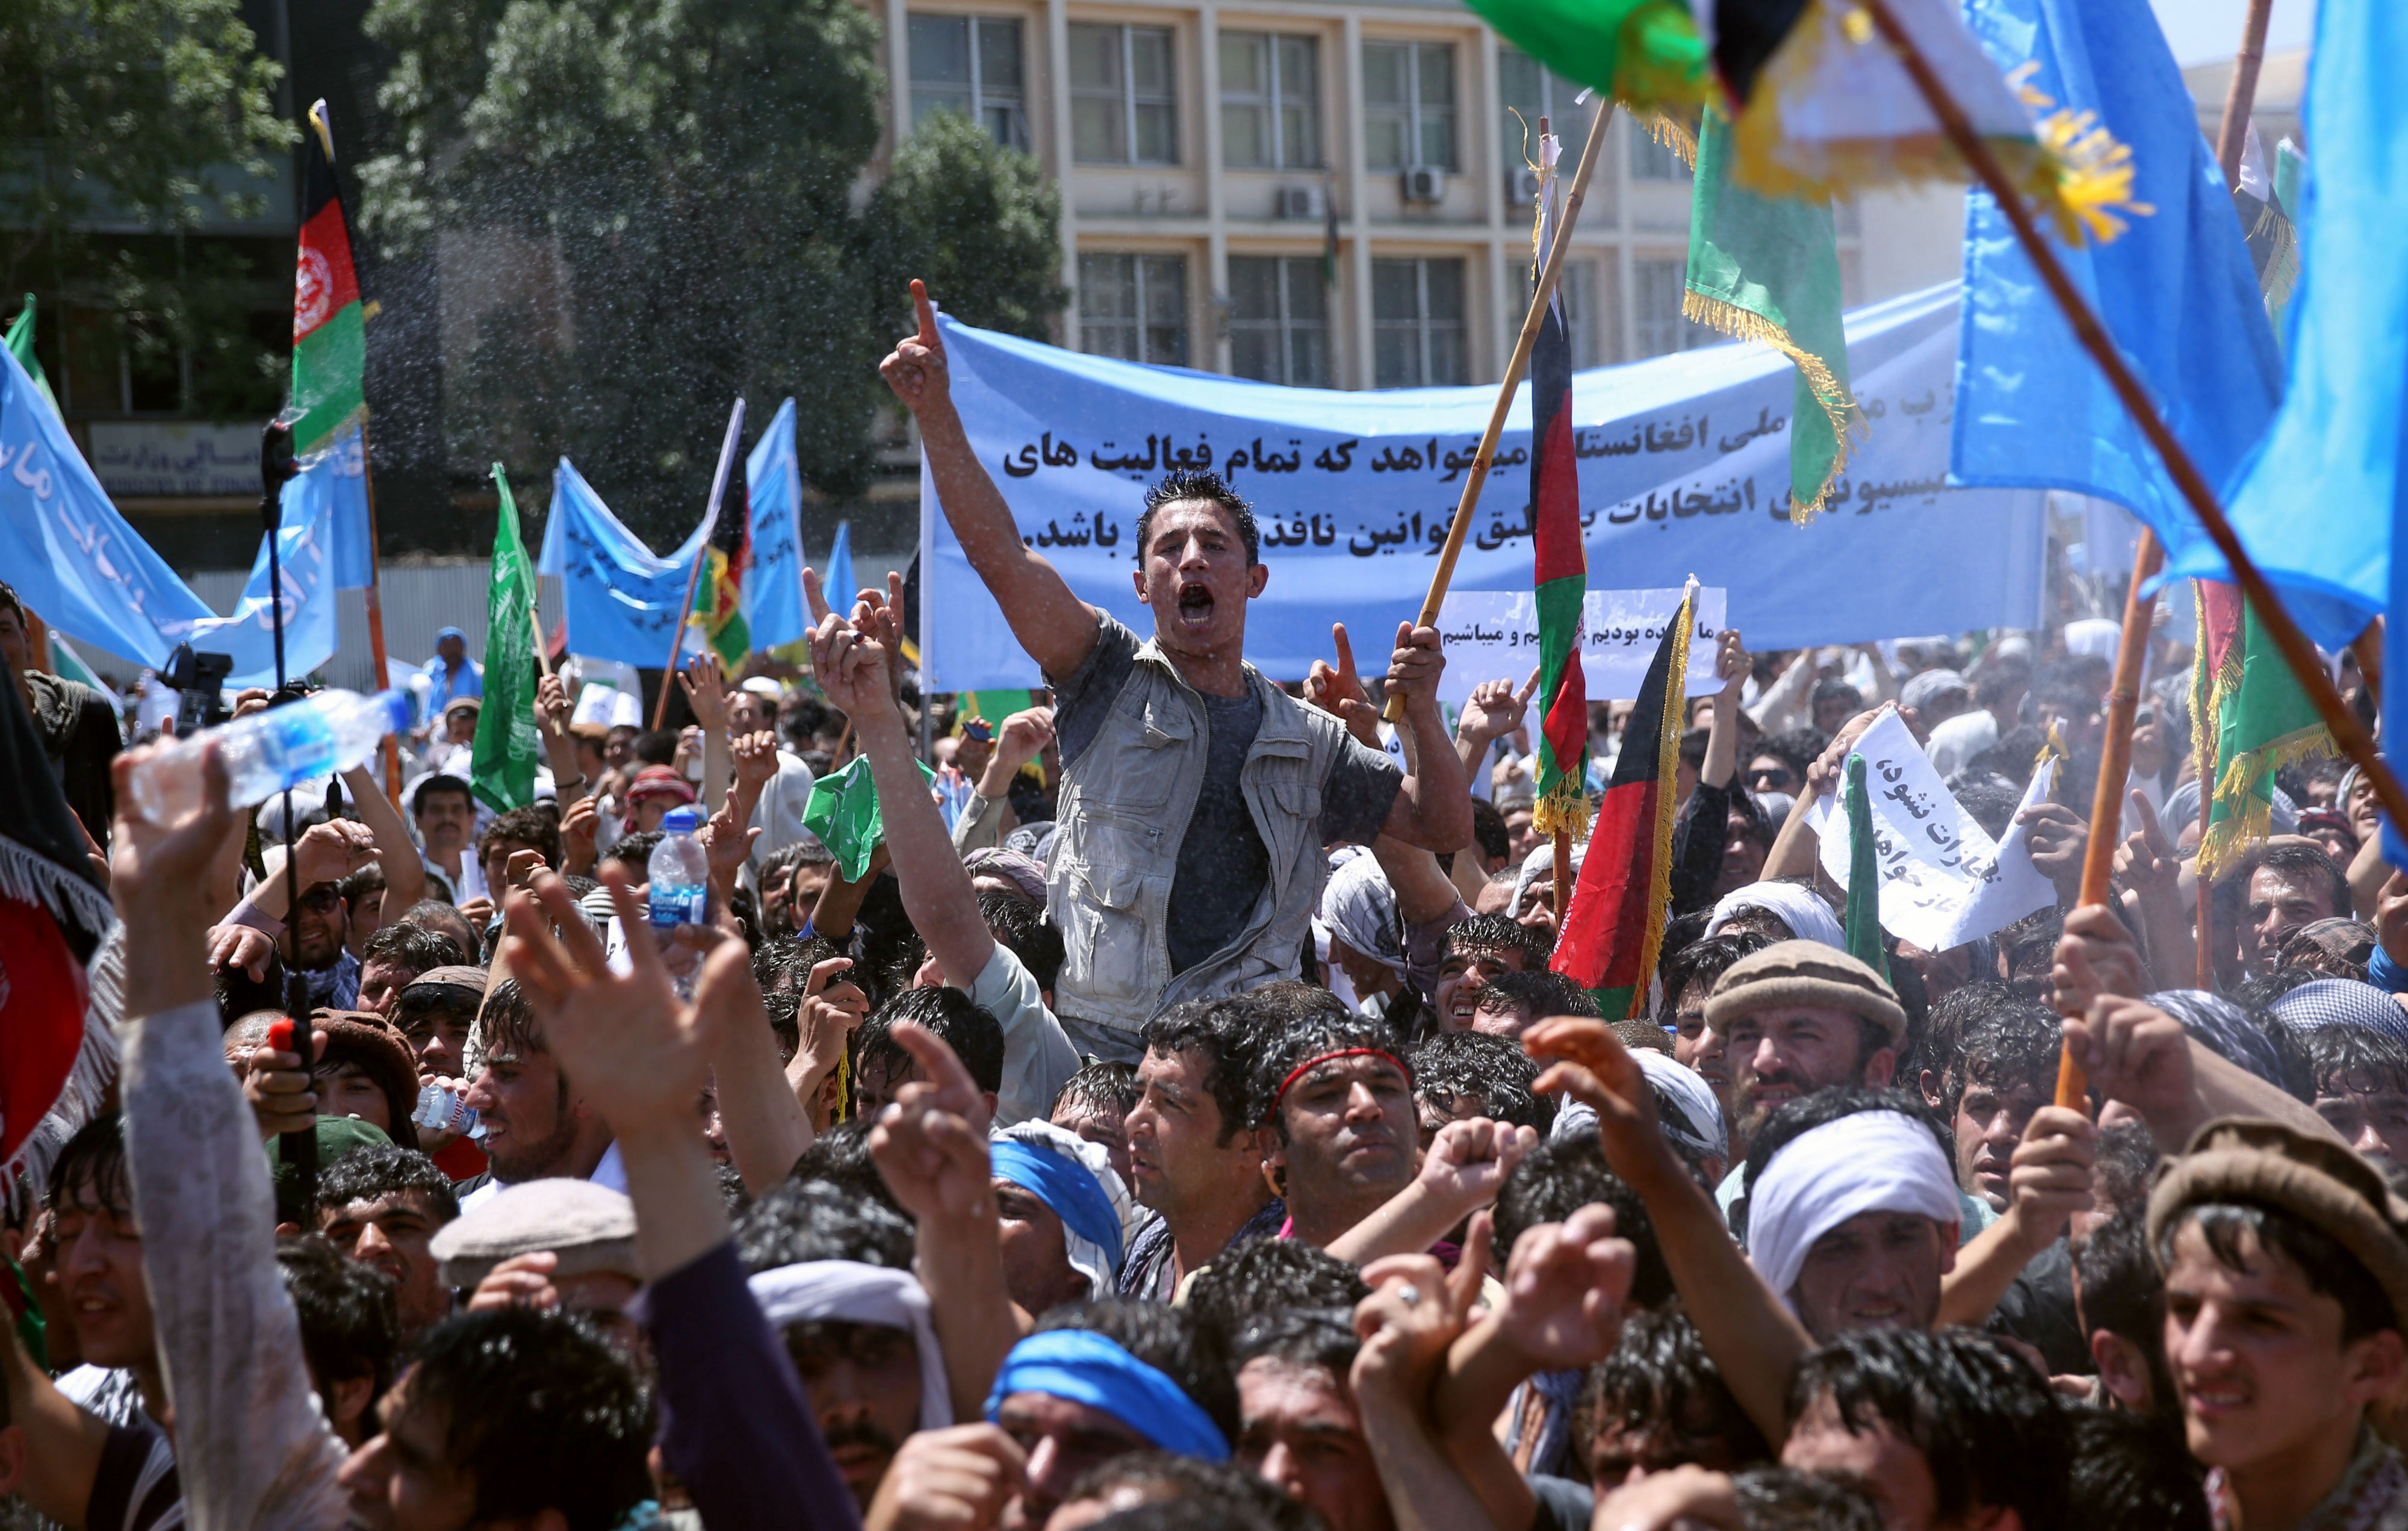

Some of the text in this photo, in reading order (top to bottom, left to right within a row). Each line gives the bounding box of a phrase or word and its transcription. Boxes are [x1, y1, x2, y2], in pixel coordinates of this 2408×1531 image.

[1575, 415, 1709, 459] افغانستا
[1719, 406, 1785, 453] ملی
[1004, 431, 1078, 477] های
[1091, 432, 1212, 482] فعالیت
[1226, 435, 1301, 482] تمام
[1314, 439, 1358, 473] که
[1609, 476, 1755, 531] انتخابات
[1443, 623, 1504, 647] میباشیم
[1509, 630, 1518, 647] و
[1592, 628, 1639, 647] بودیم
[1699, 622, 1714, 640] ما
